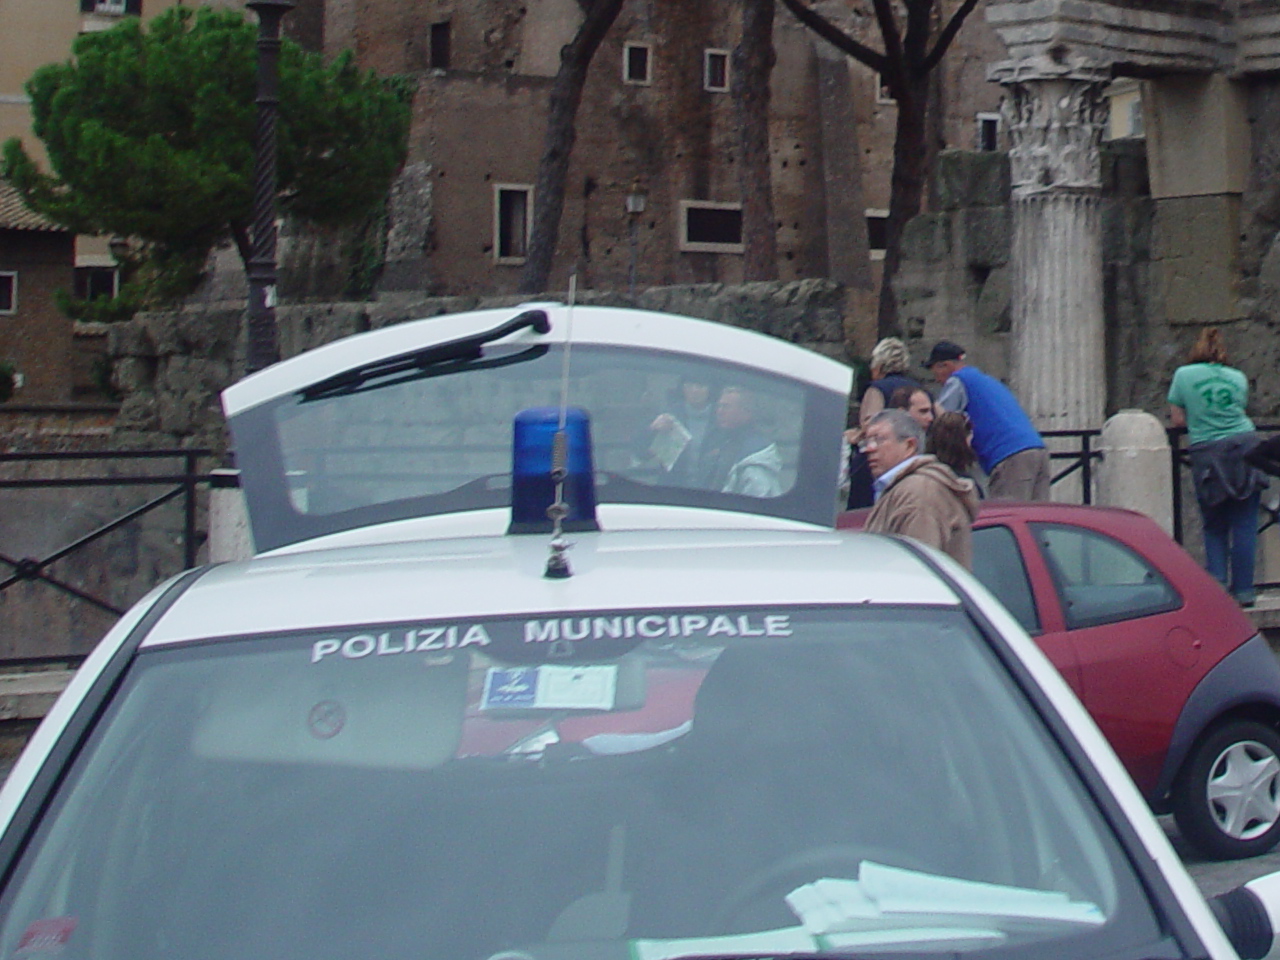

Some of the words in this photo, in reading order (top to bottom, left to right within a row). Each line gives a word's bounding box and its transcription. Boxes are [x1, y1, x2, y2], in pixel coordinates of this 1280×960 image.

[1201, 389, 1233, 409] 13
[311, 624, 491, 663] POLIZIA
[524, 614, 793, 643] MUNICIPALE
